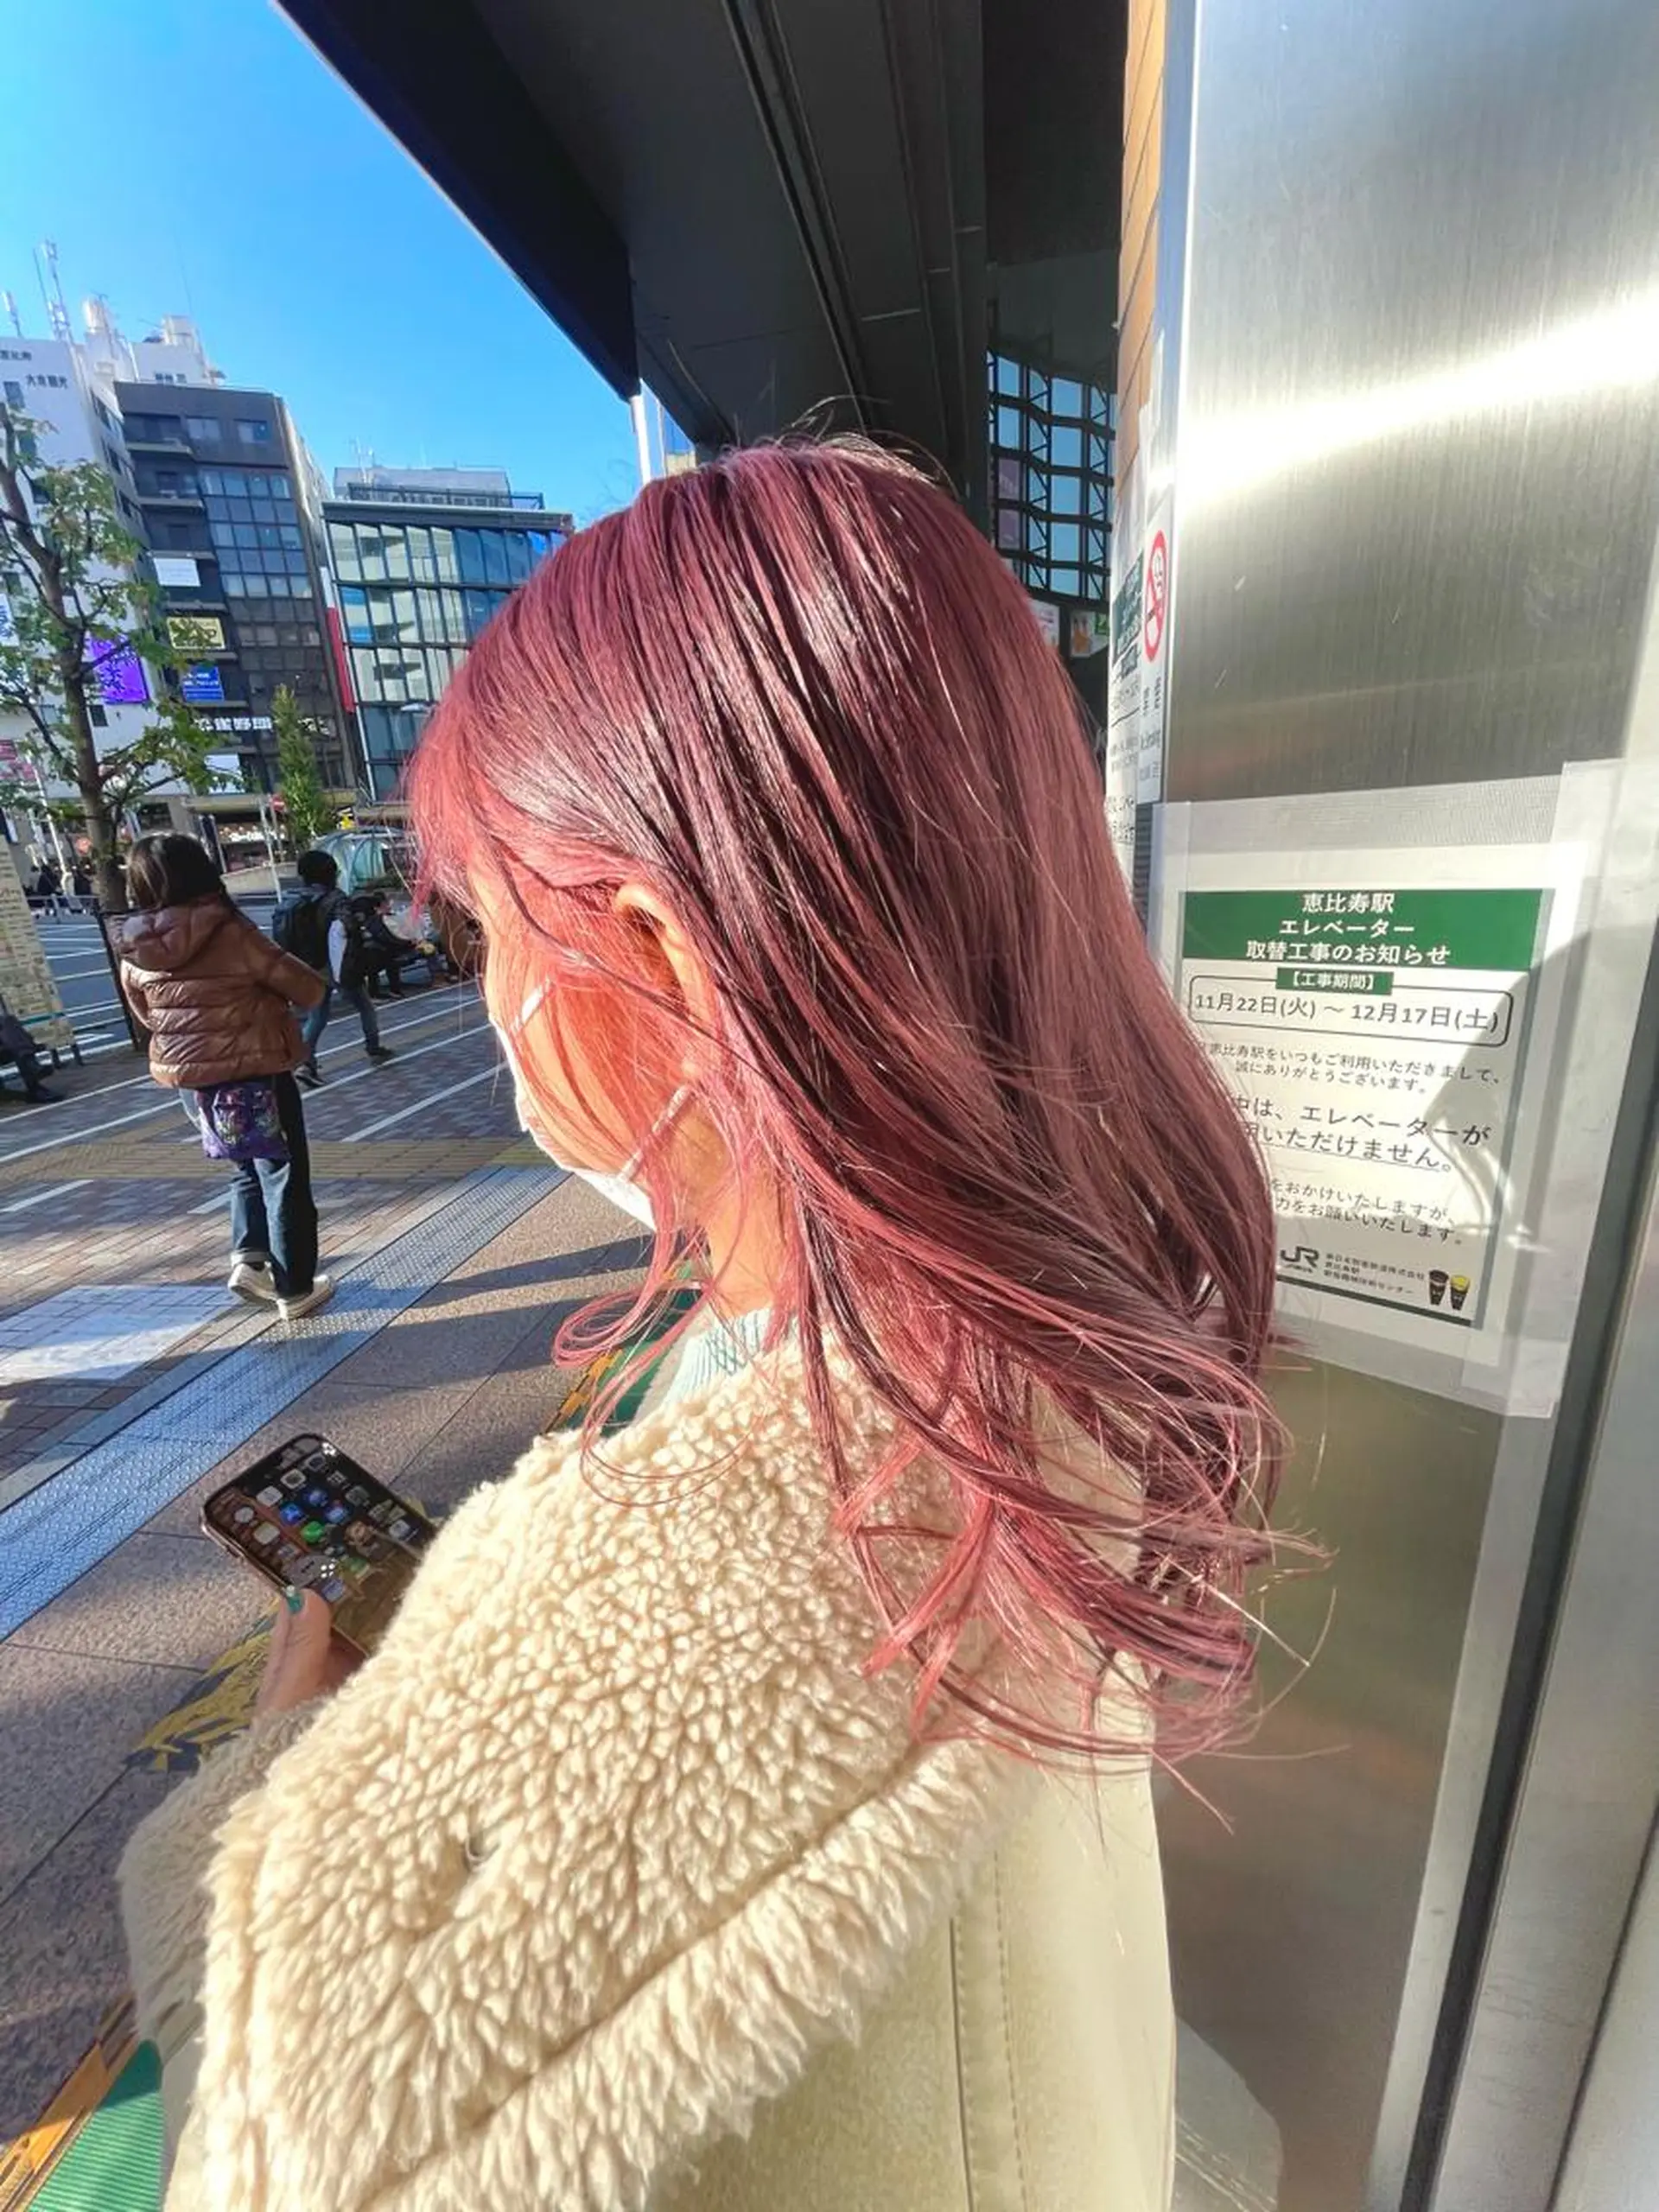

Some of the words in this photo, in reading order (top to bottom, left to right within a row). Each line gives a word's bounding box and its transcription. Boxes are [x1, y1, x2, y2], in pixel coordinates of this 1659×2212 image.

[1302, 892, 1395, 914] 恵比寿駅
[1279, 918, 1414, 938] エレベーター
[1246, 940, 1451, 965] 取替工事のお知らせ
[1195, 993, 1316, 1020] 11月22日(火)
[1351, 1002, 1498, 1033] 12月17日(土)
[1236, 1059, 1426, 1094] 誠にありがとうございます。
[1281, 1245, 1319, 1268] JR
